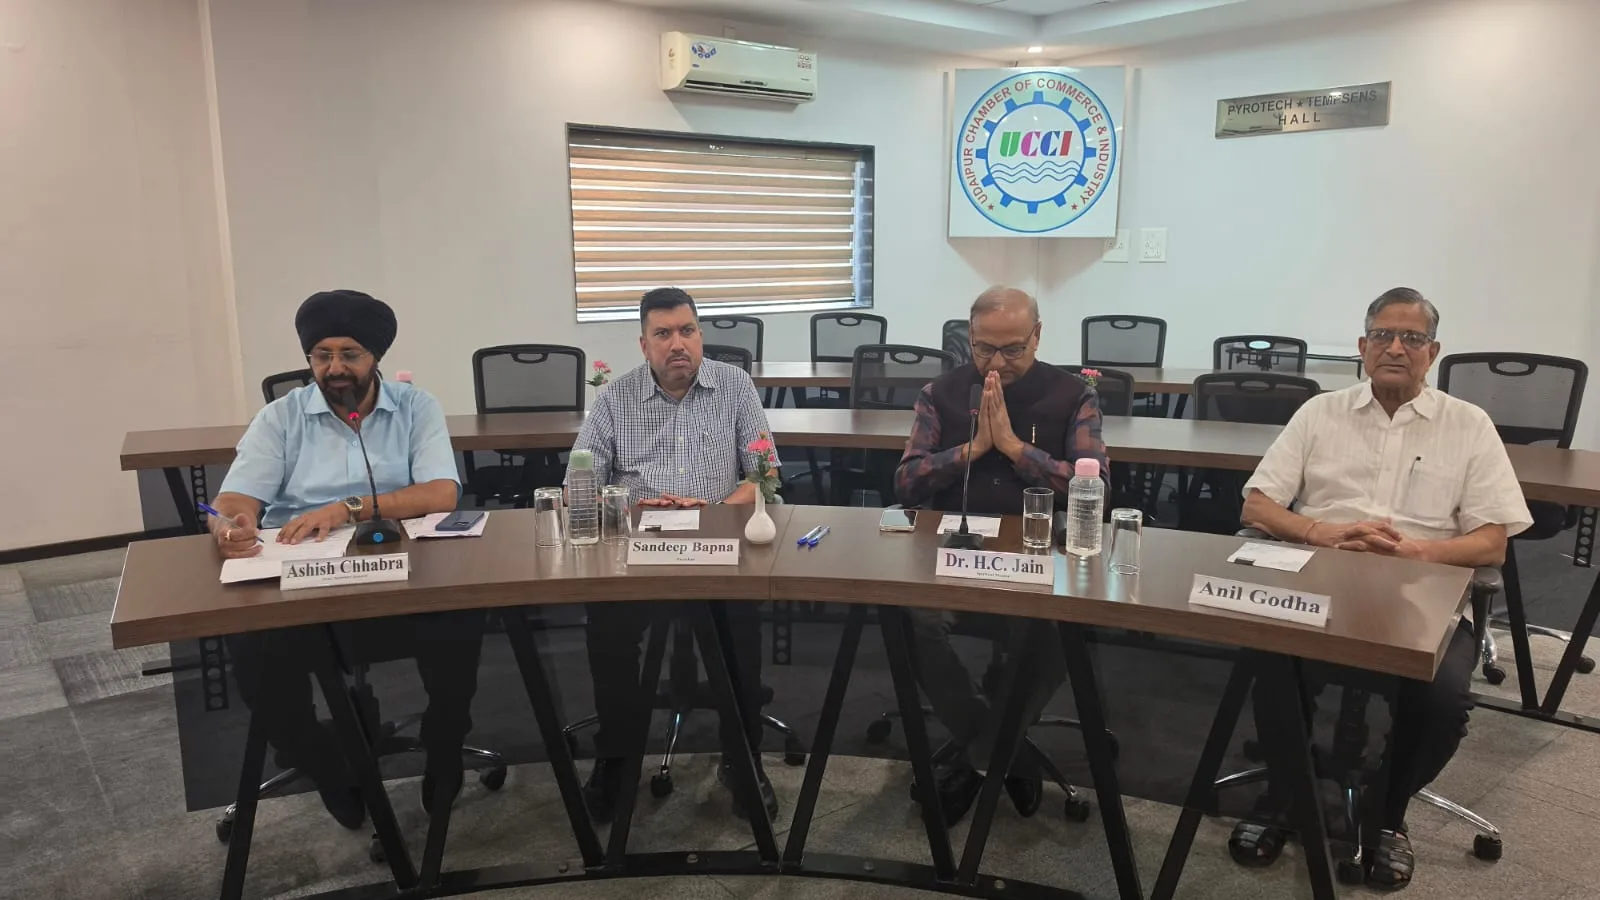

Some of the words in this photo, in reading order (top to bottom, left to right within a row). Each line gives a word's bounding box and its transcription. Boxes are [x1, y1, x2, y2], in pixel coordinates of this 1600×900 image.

[1014, 79, 1032, 92] OF
[1037, 78, 1103, 124] COMMERCE
[1227, 99, 1292, 116] PYROTECH
[1307, 90, 1377, 108] TEMPSENS
[965, 87, 1012, 143] CHAMBER
[1278, 111, 1321, 126] HALL
[999, 130, 1073, 157] UCCI
[1096, 126, 1107, 136] &
[963, 148, 988, 204] UDAIPUR
[1080, 138, 1109, 205] INDUSTRY
[632, 541, 688, 555] Sandeep
[693, 542, 734, 555] Bapna
[286, 561, 335, 579] Ashish
[340, 557, 404, 574] Chhabra
[945, 553, 969, 569] Dr.
[974, 555, 1007, 572] H.C.
[1012, 559, 1044, 575] Jain
[1199, 581, 1243, 600] Anil
[1250, 589, 1321, 614] Godha
